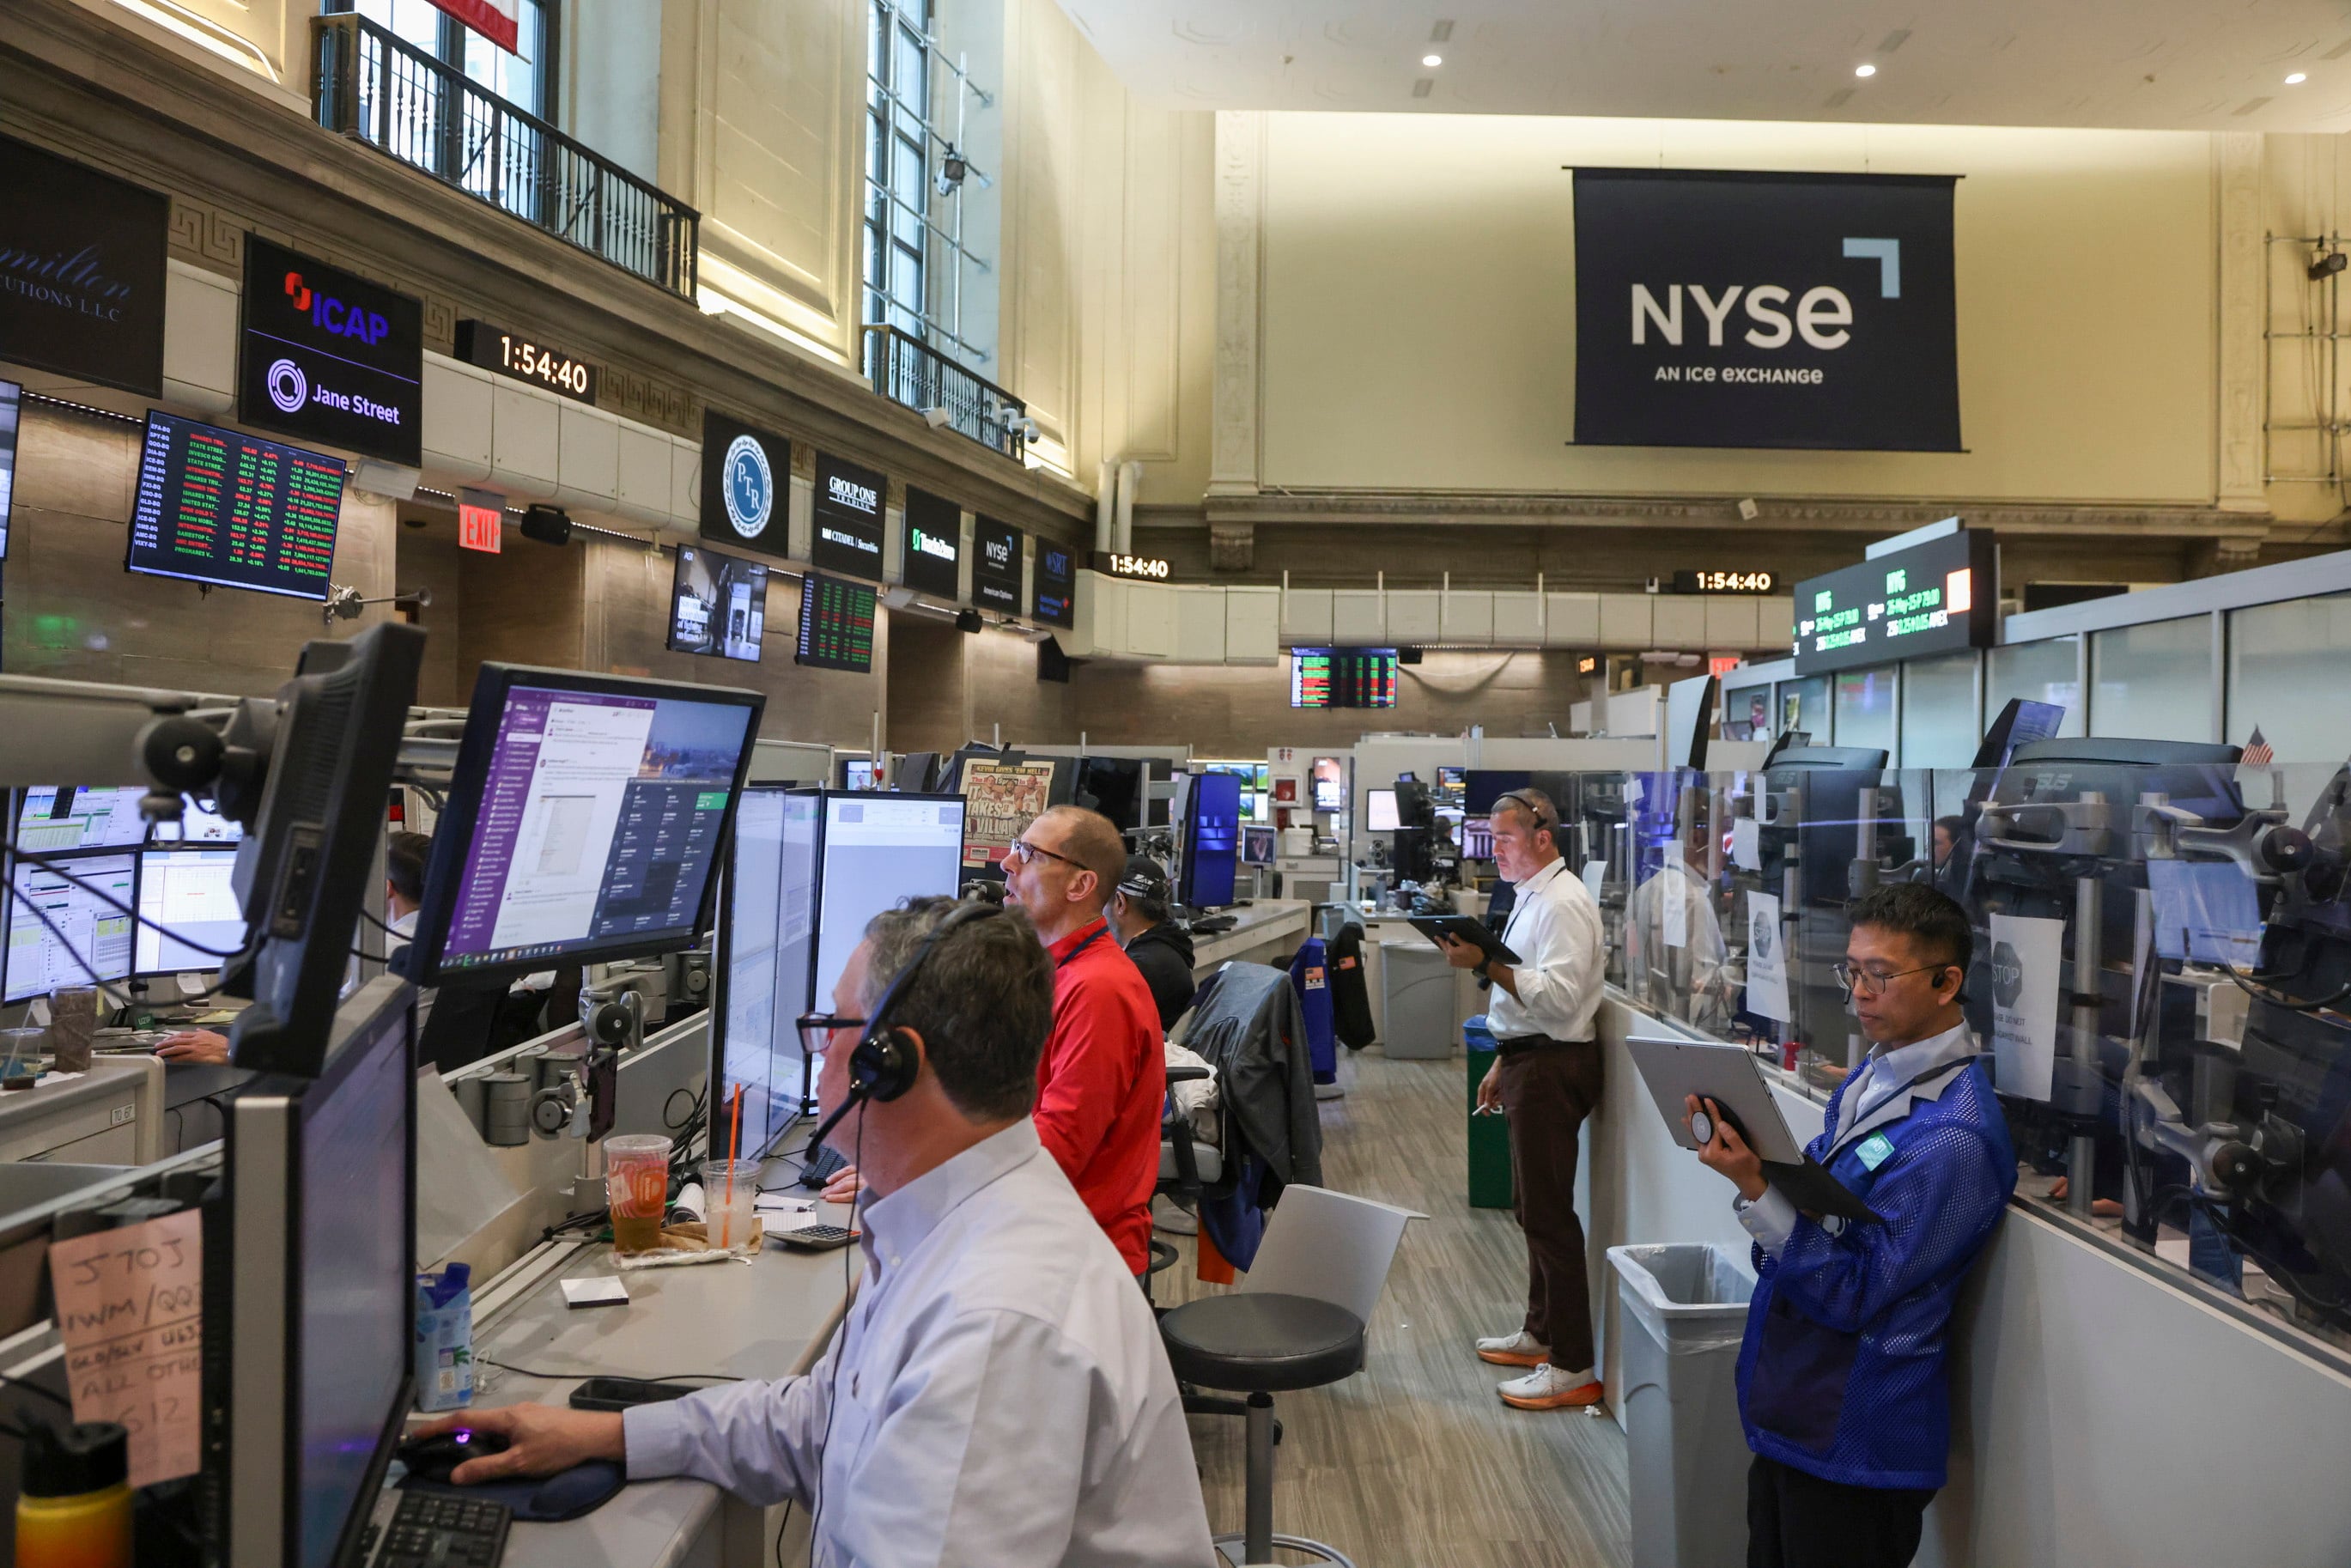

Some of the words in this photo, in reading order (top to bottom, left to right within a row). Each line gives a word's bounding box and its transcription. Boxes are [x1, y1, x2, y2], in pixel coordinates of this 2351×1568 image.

[0, 244, 131, 299] milton
[313, 292, 389, 346] ICAP
[501, 336, 587, 394] 1:54:40
[1655, 367, 1680, 381] AN
[312, 384, 350, 412] Jane
[352, 395, 400, 425] Street
[149, 431, 169, 441] SPY-BQ
[189, 441, 205, 450] STATE
[146, 456, 164, 465] ICE-BQ
[147, 447, 166, 457] DIA-BQ
[188, 449, 210, 459] INVESCO
[829, 476, 859, 498] GROUP
[859, 487, 877, 503] ONE
[140, 497, 160, 506] GLD-BQ
[138, 514, 156, 522] ICE-BQ
[466, 511, 497, 549] EXIT
[135, 538, 156, 547] VIXY-BQ
[1110, 555, 1168, 578] 1:54:40
[1697, 572, 1771, 590] 1:54:40
[1992, 963, 2020, 985] STOP
[67, 1282, 201, 1330] IWM/QQ
[146, 1358, 200, 1381] OTHE
